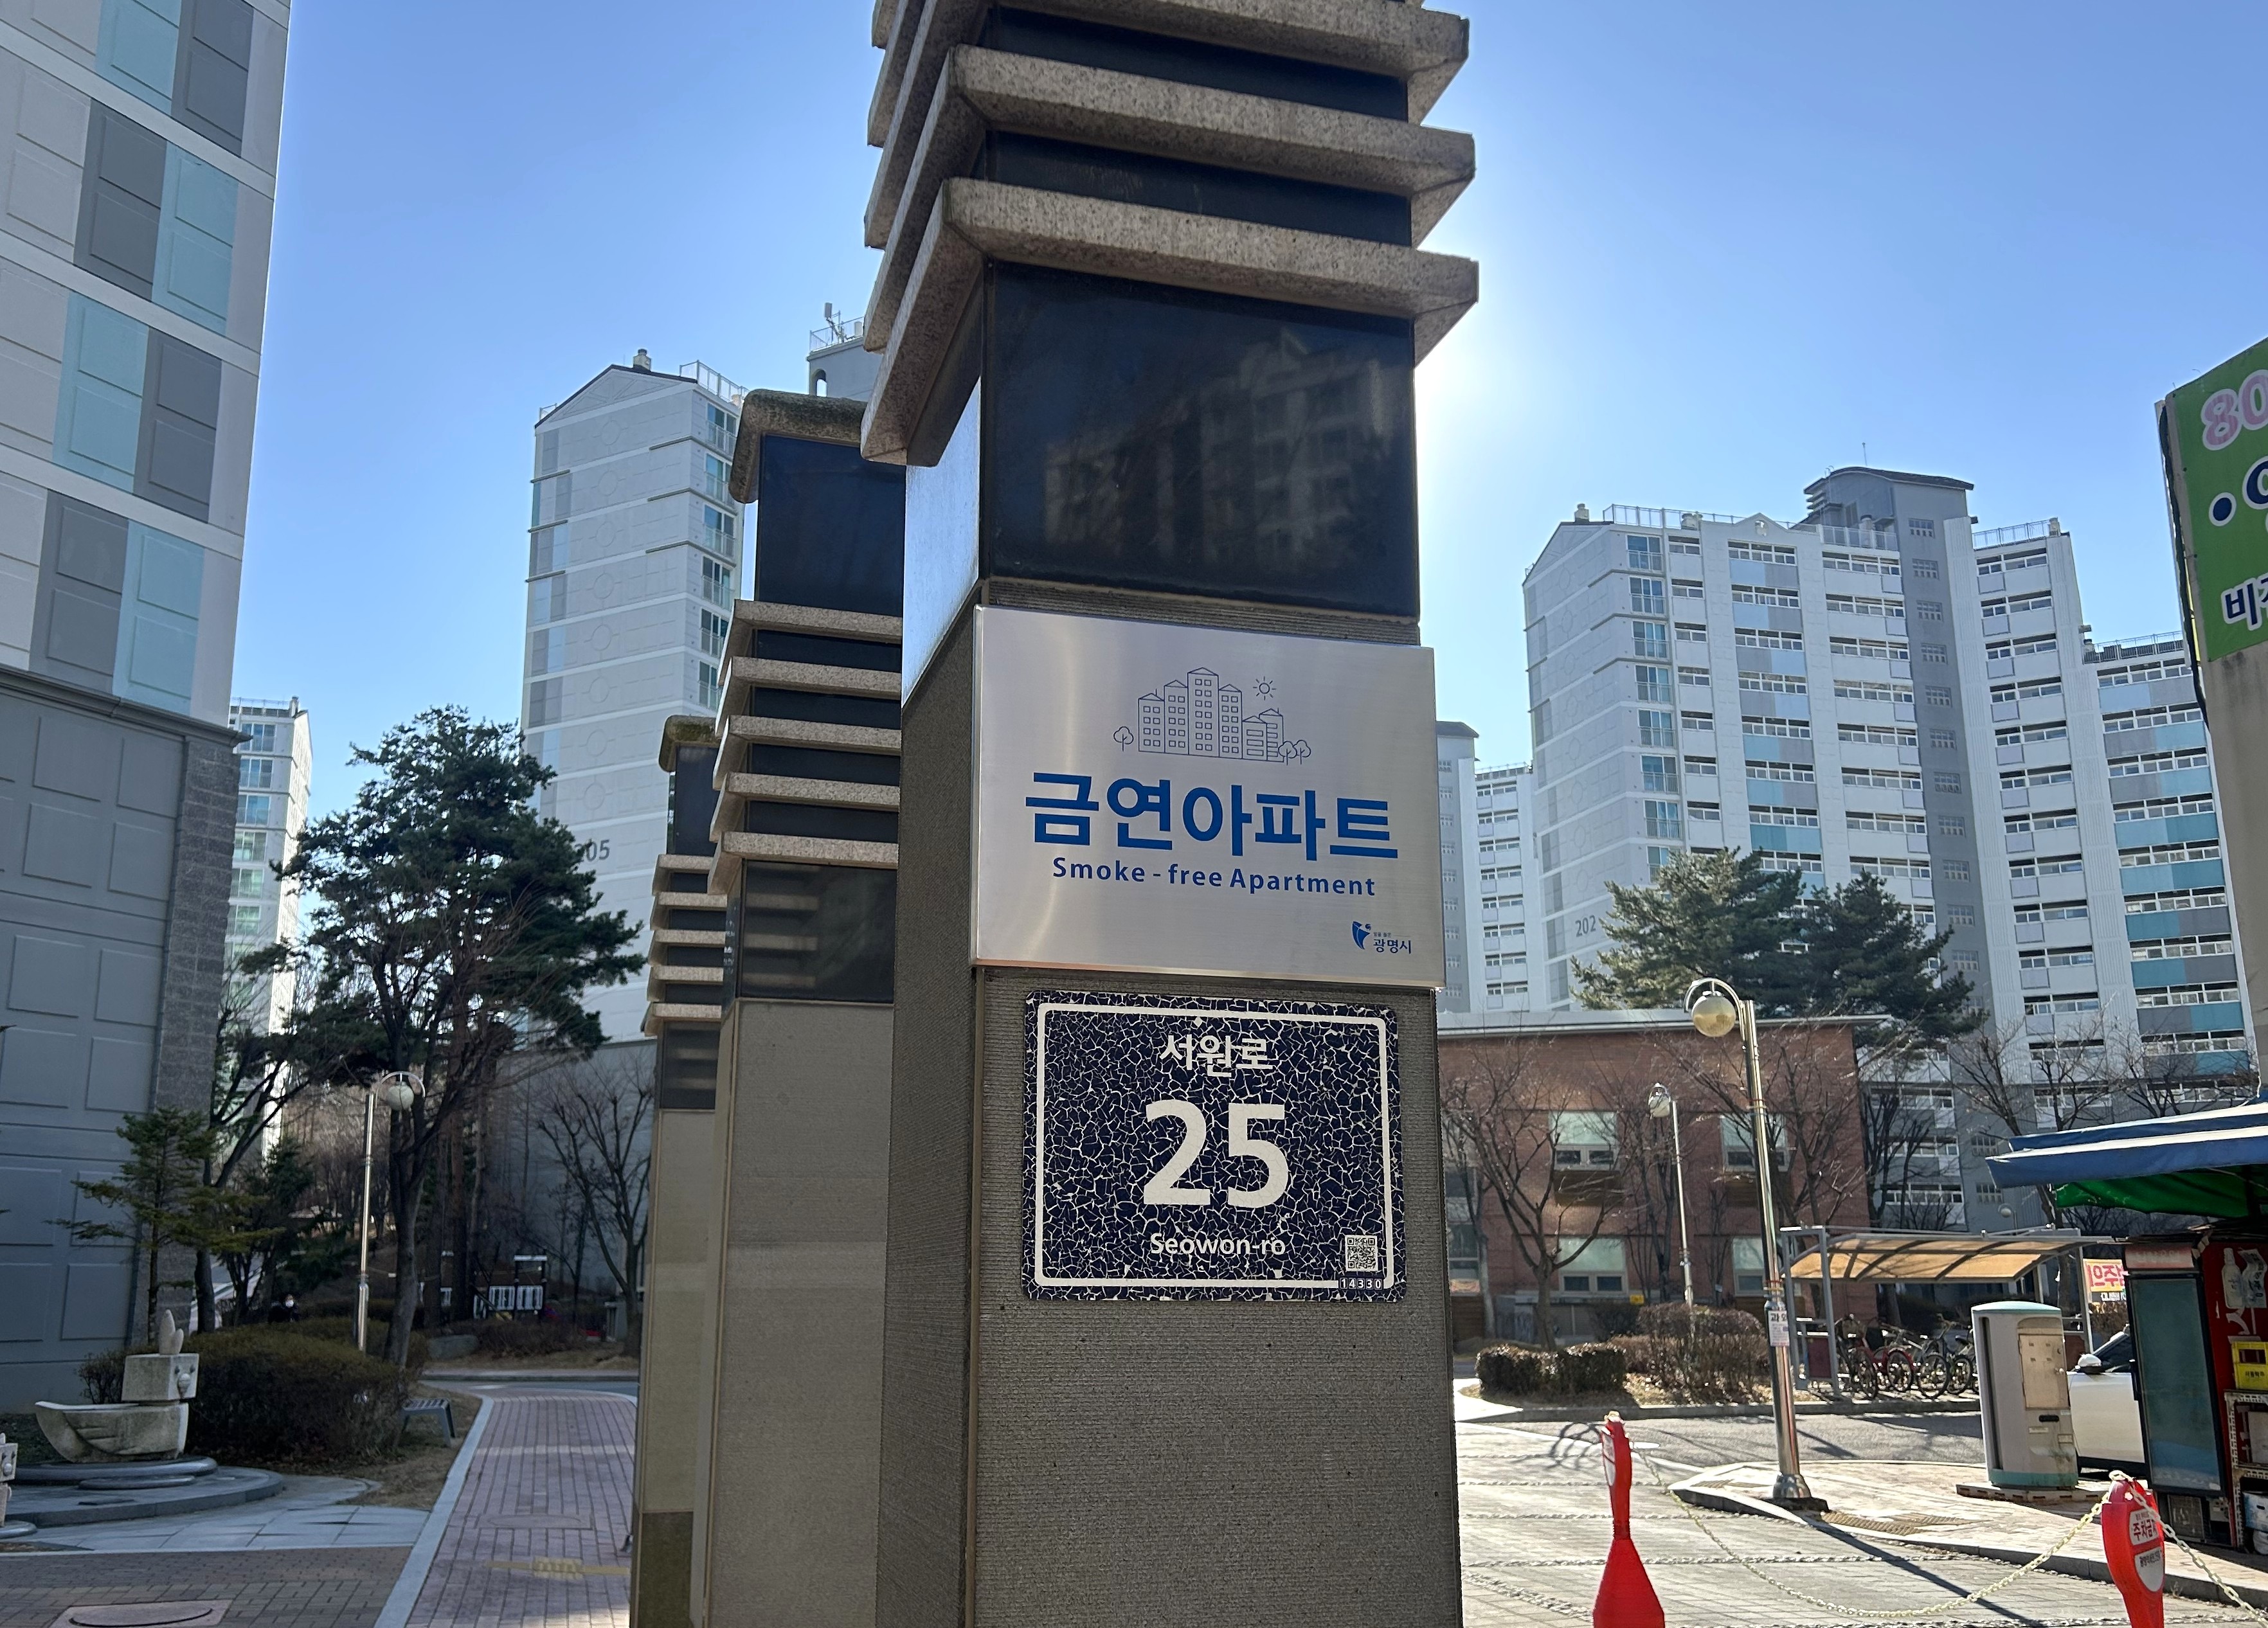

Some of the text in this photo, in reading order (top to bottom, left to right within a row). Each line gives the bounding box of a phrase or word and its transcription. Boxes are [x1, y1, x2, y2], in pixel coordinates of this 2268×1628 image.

[1025, 772, 1398, 862] 금연아파트
[574, 839, 610, 862] 05
[1230, 868, 1376, 897] Apartment
[1575, 915, 1596, 937] 202
[1372, 938, 1412, 954] 광명시
[1158, 1034, 1274, 1077] 서원로
[1144, 1099, 1290, 1208] 25
[1150, 1233, 1286, 1257] Seowon-ro
[1340, 1278, 1382, 1289] 14330
